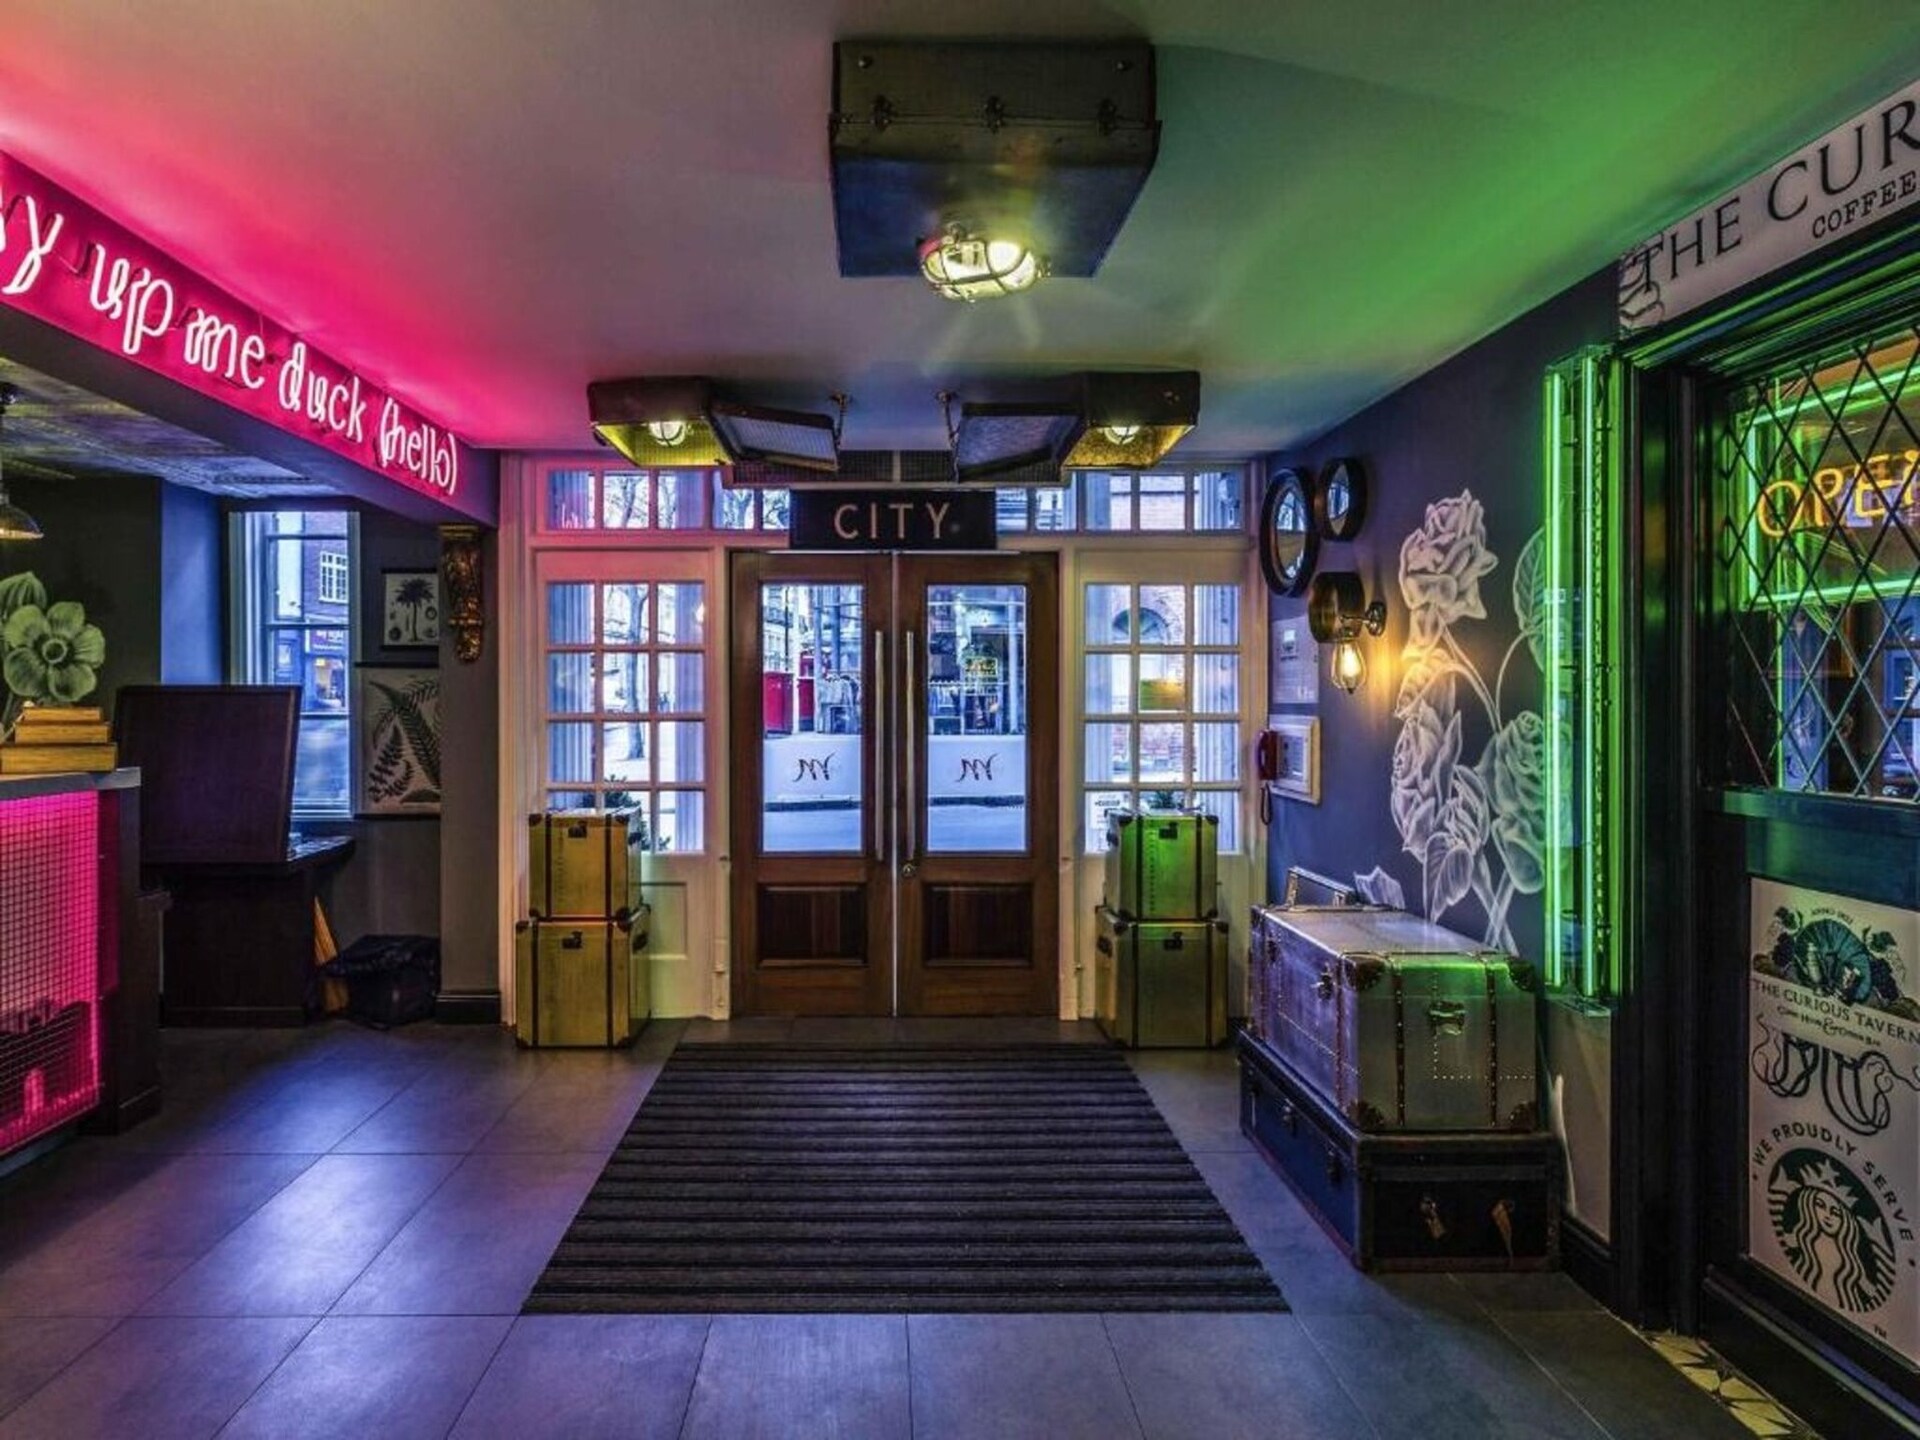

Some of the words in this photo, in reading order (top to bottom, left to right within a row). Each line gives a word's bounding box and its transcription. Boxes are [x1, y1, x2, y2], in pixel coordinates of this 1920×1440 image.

[1630, 196, 1743, 295] THE
[1766, 99, 1920, 222] CUR
[1811, 170, 1917, 239] COFFEE
[0, 185, 64, 294] y
[90, 243, 173, 355] up
[184, 308, 265, 389] me
[279, 341, 366, 443] duck
[380, 397, 457, 495] (hello)
[833, 502, 951, 540] CITY
[1751, 978, 1781, 999] THE
[1783, 989, 1850, 1021] CURIOUS
[1854, 1011, 1920, 1044] TAVERN
[1752, 1138, 1773, 1167] WE
[1772, 1121, 1858, 1157] PROUDLY
[1863, 1160, 1915, 1243] SERVE
